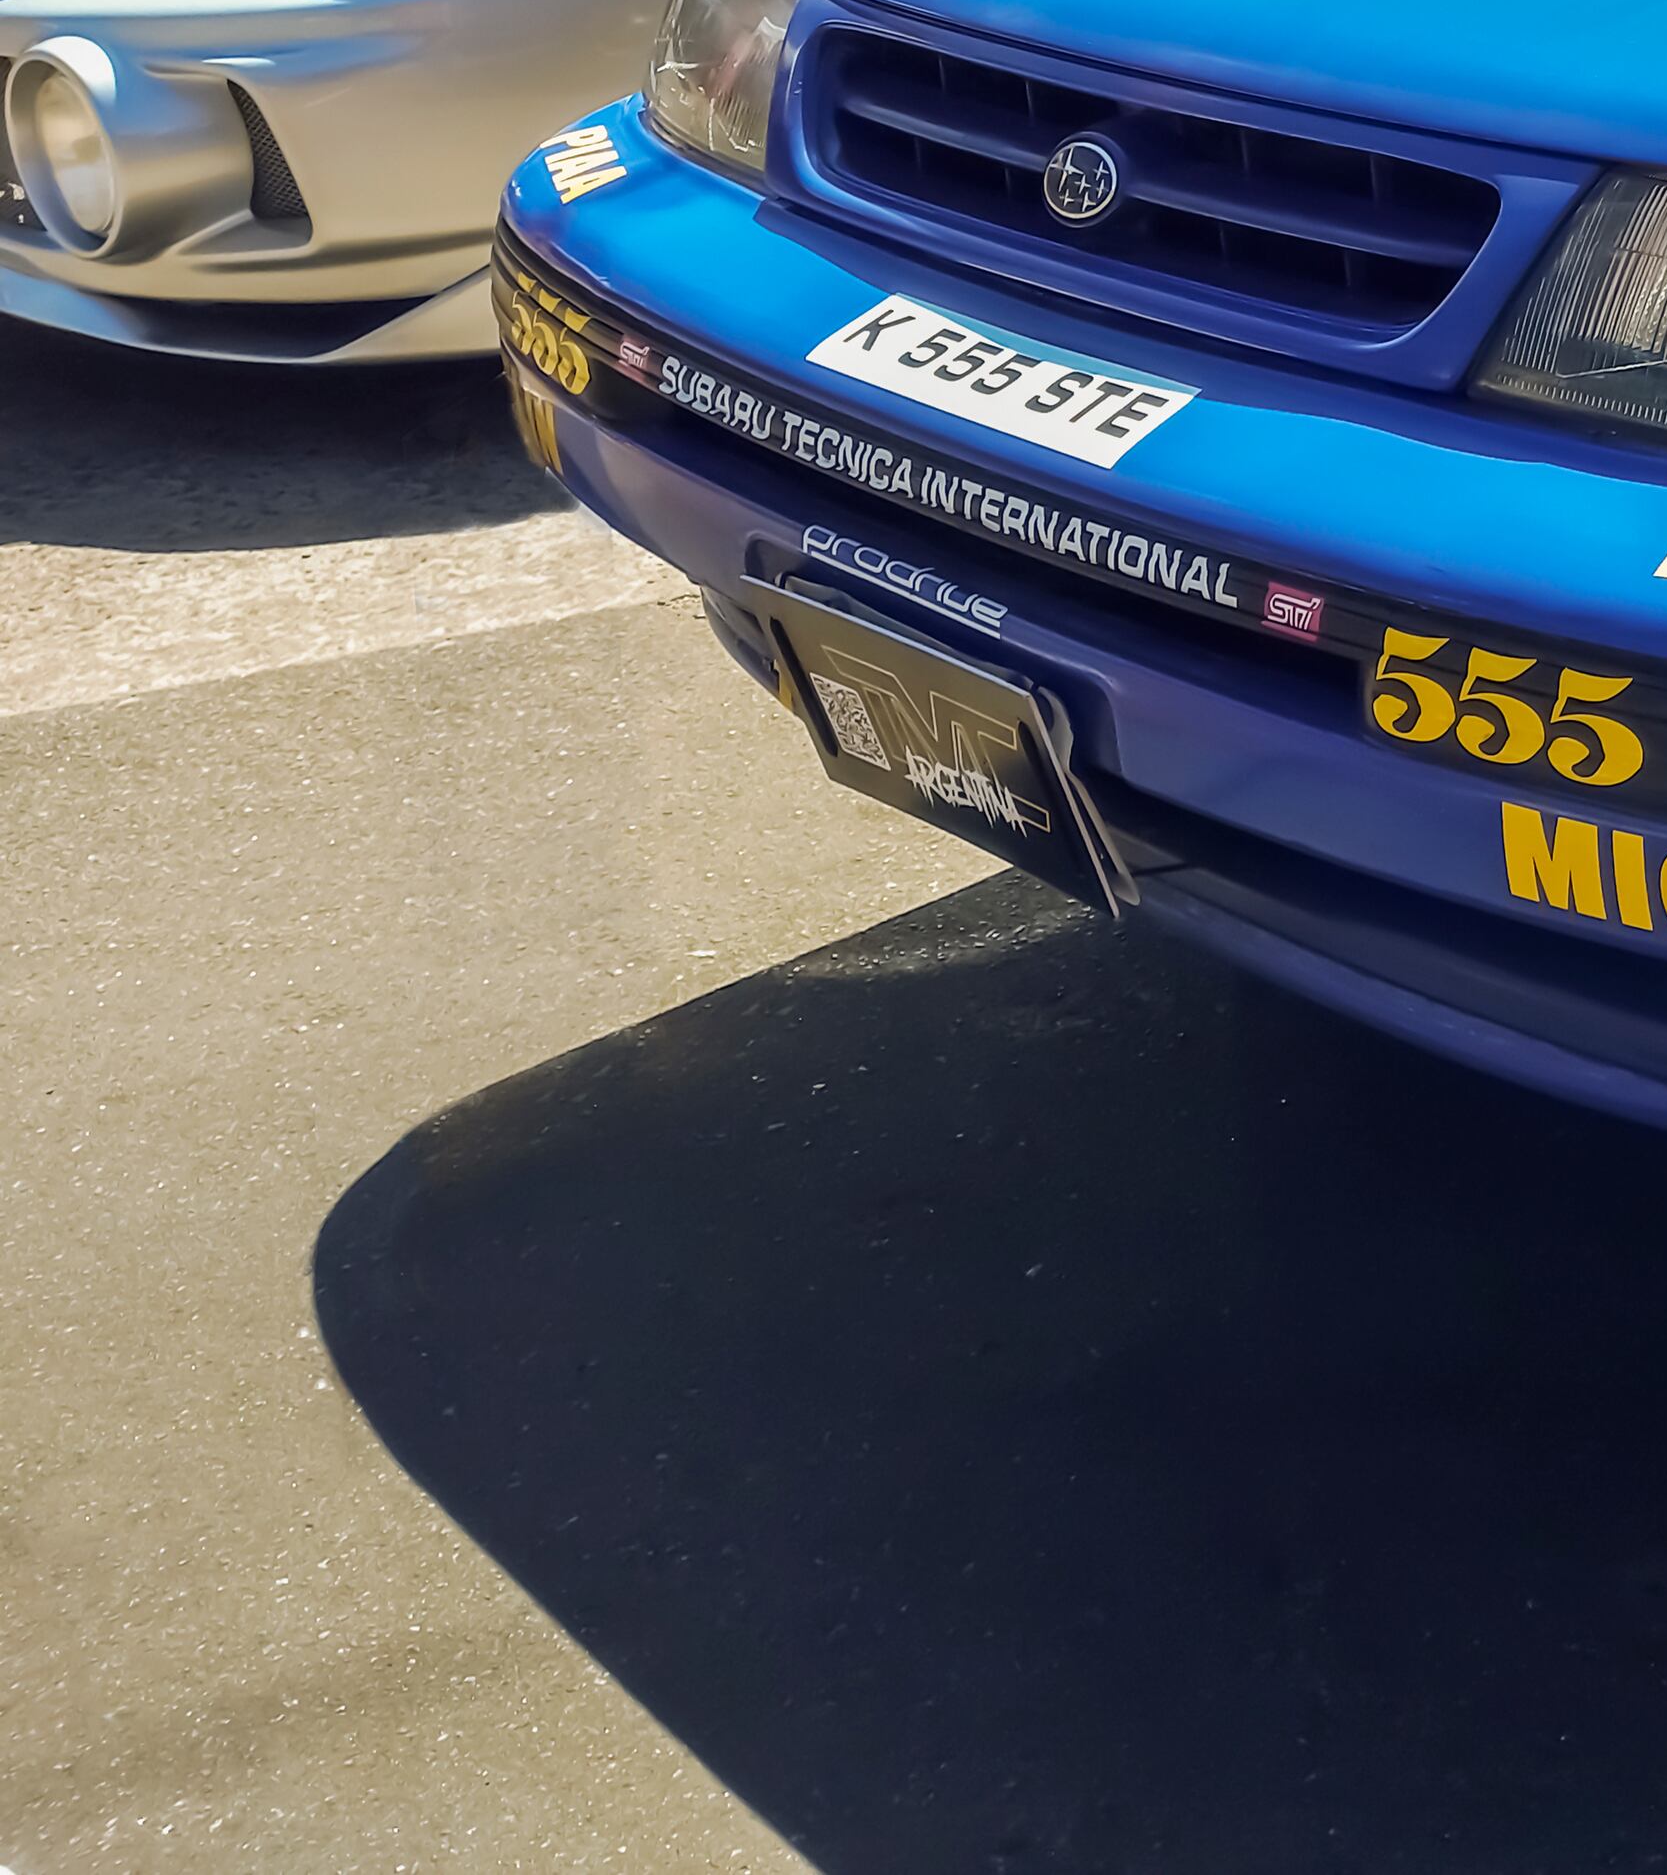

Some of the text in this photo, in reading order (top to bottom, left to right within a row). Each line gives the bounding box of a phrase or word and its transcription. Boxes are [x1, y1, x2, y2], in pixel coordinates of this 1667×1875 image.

[541, 123, 629, 205] PIAA
[846, 308, 1169, 438] K 555 STE
[657, 355, 773, 442] SUBARU
[780, 410, 915, 501] TECNICA
[919, 467, 1240, 609] INTERNATIONAL
[1372, 626, 1645, 787] 555
[903, 745, 1028, 838] ARGENTINA
